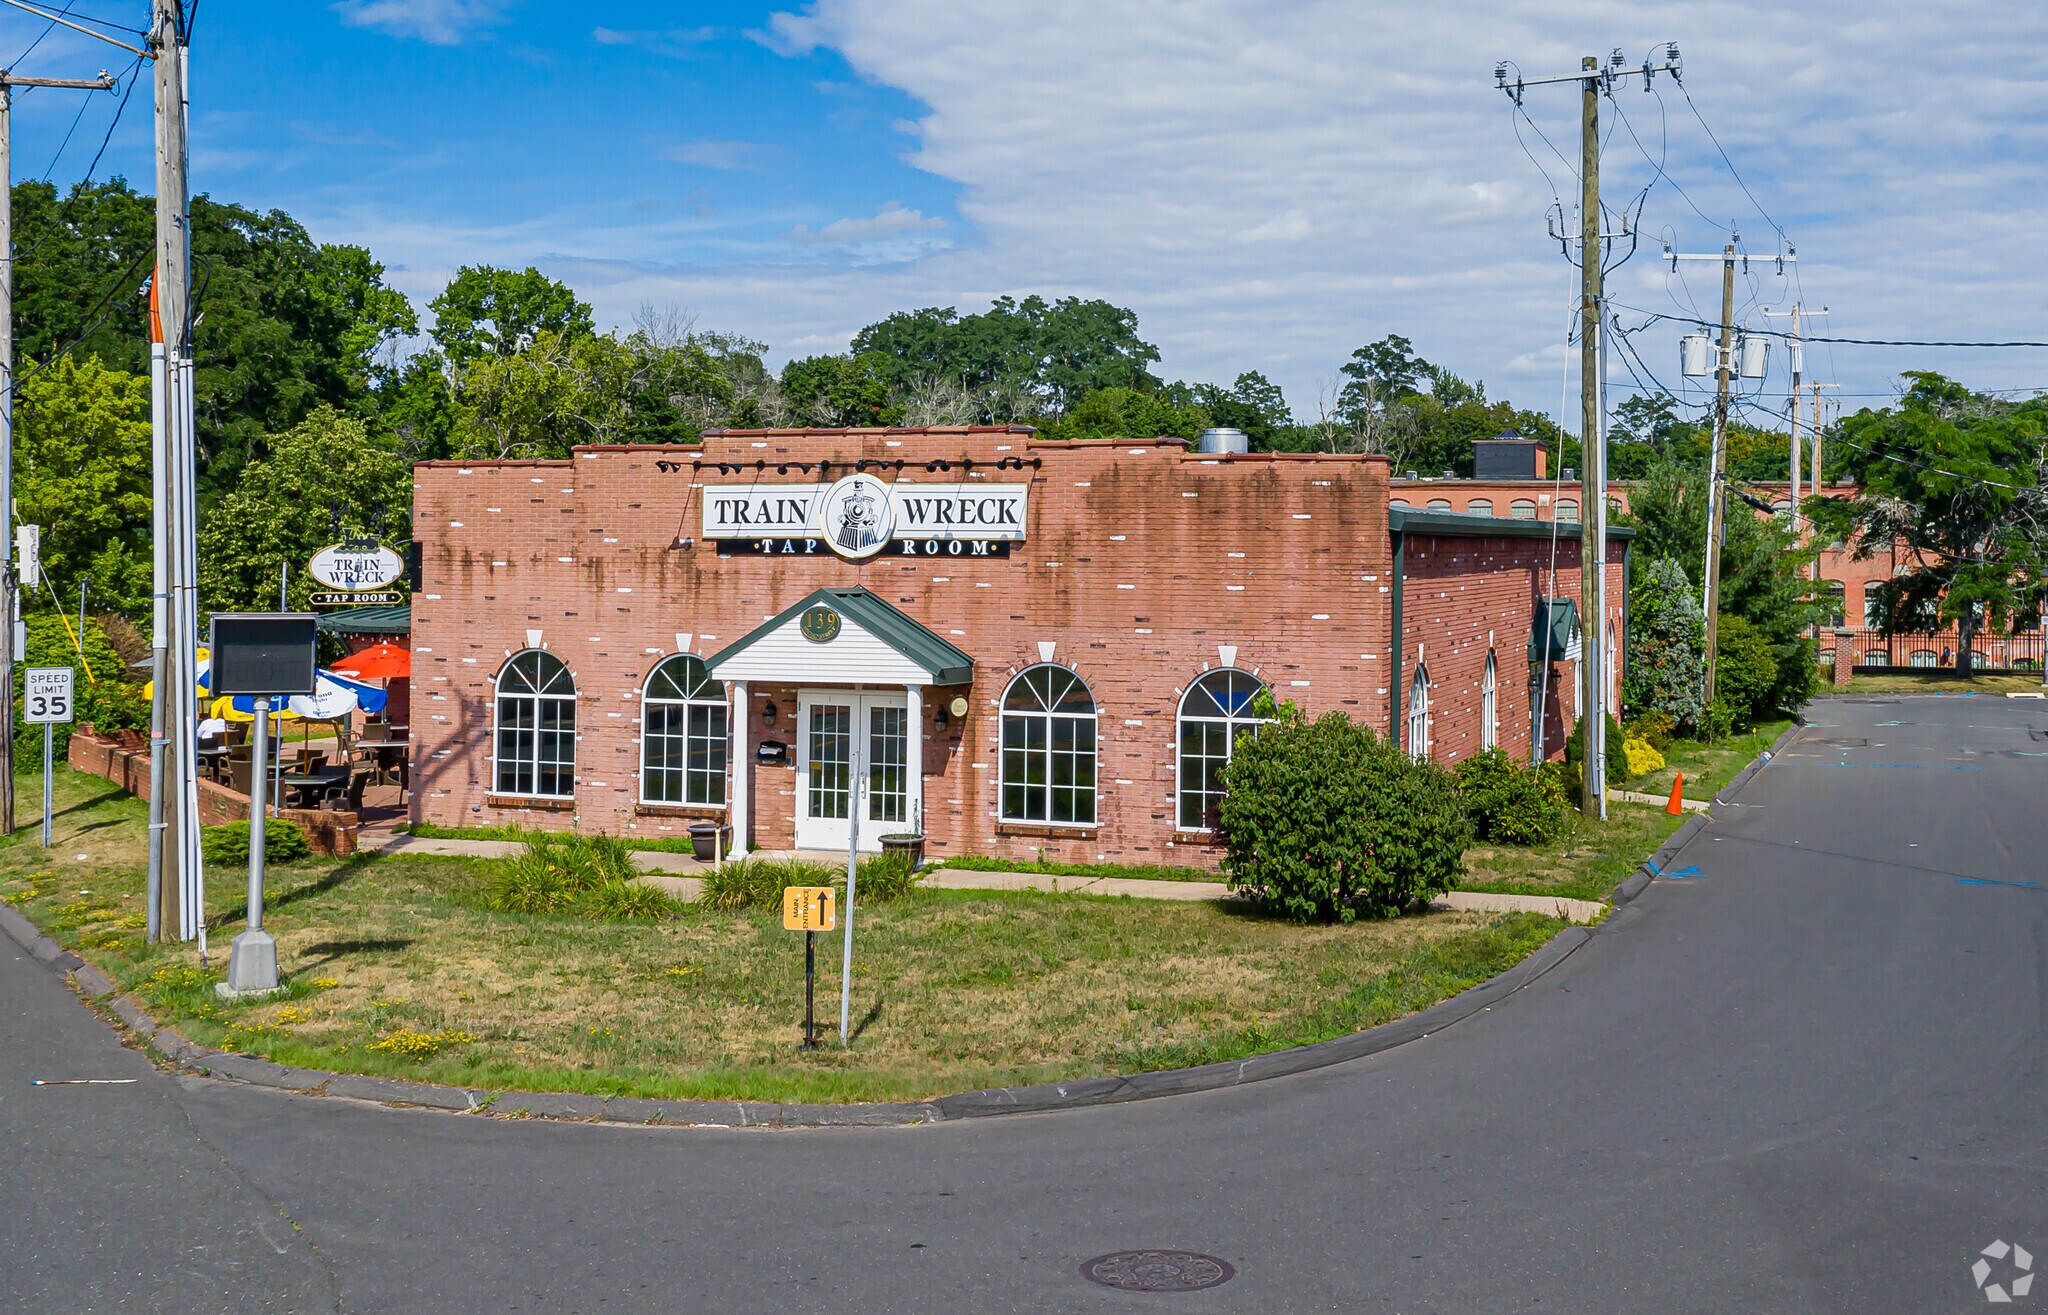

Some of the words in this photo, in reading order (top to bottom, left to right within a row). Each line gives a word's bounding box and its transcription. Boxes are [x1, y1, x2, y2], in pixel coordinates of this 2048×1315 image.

[714, 499, 809, 525] TRAIN
[902, 498, 1019, 525] WRECK
[761, 538, 817, 554] TAP
[902, 540, 989, 556] ROOM
[329, 571, 385, 583] WRECK
[325, 594, 349, 603] TAP
[354, 593, 388, 602] ROOM
[806, 613, 836, 630] 139
[30, 674, 69, 684] SPEED
[34, 686, 64, 695] LIMIT
[30, 696, 67, 717] 35
